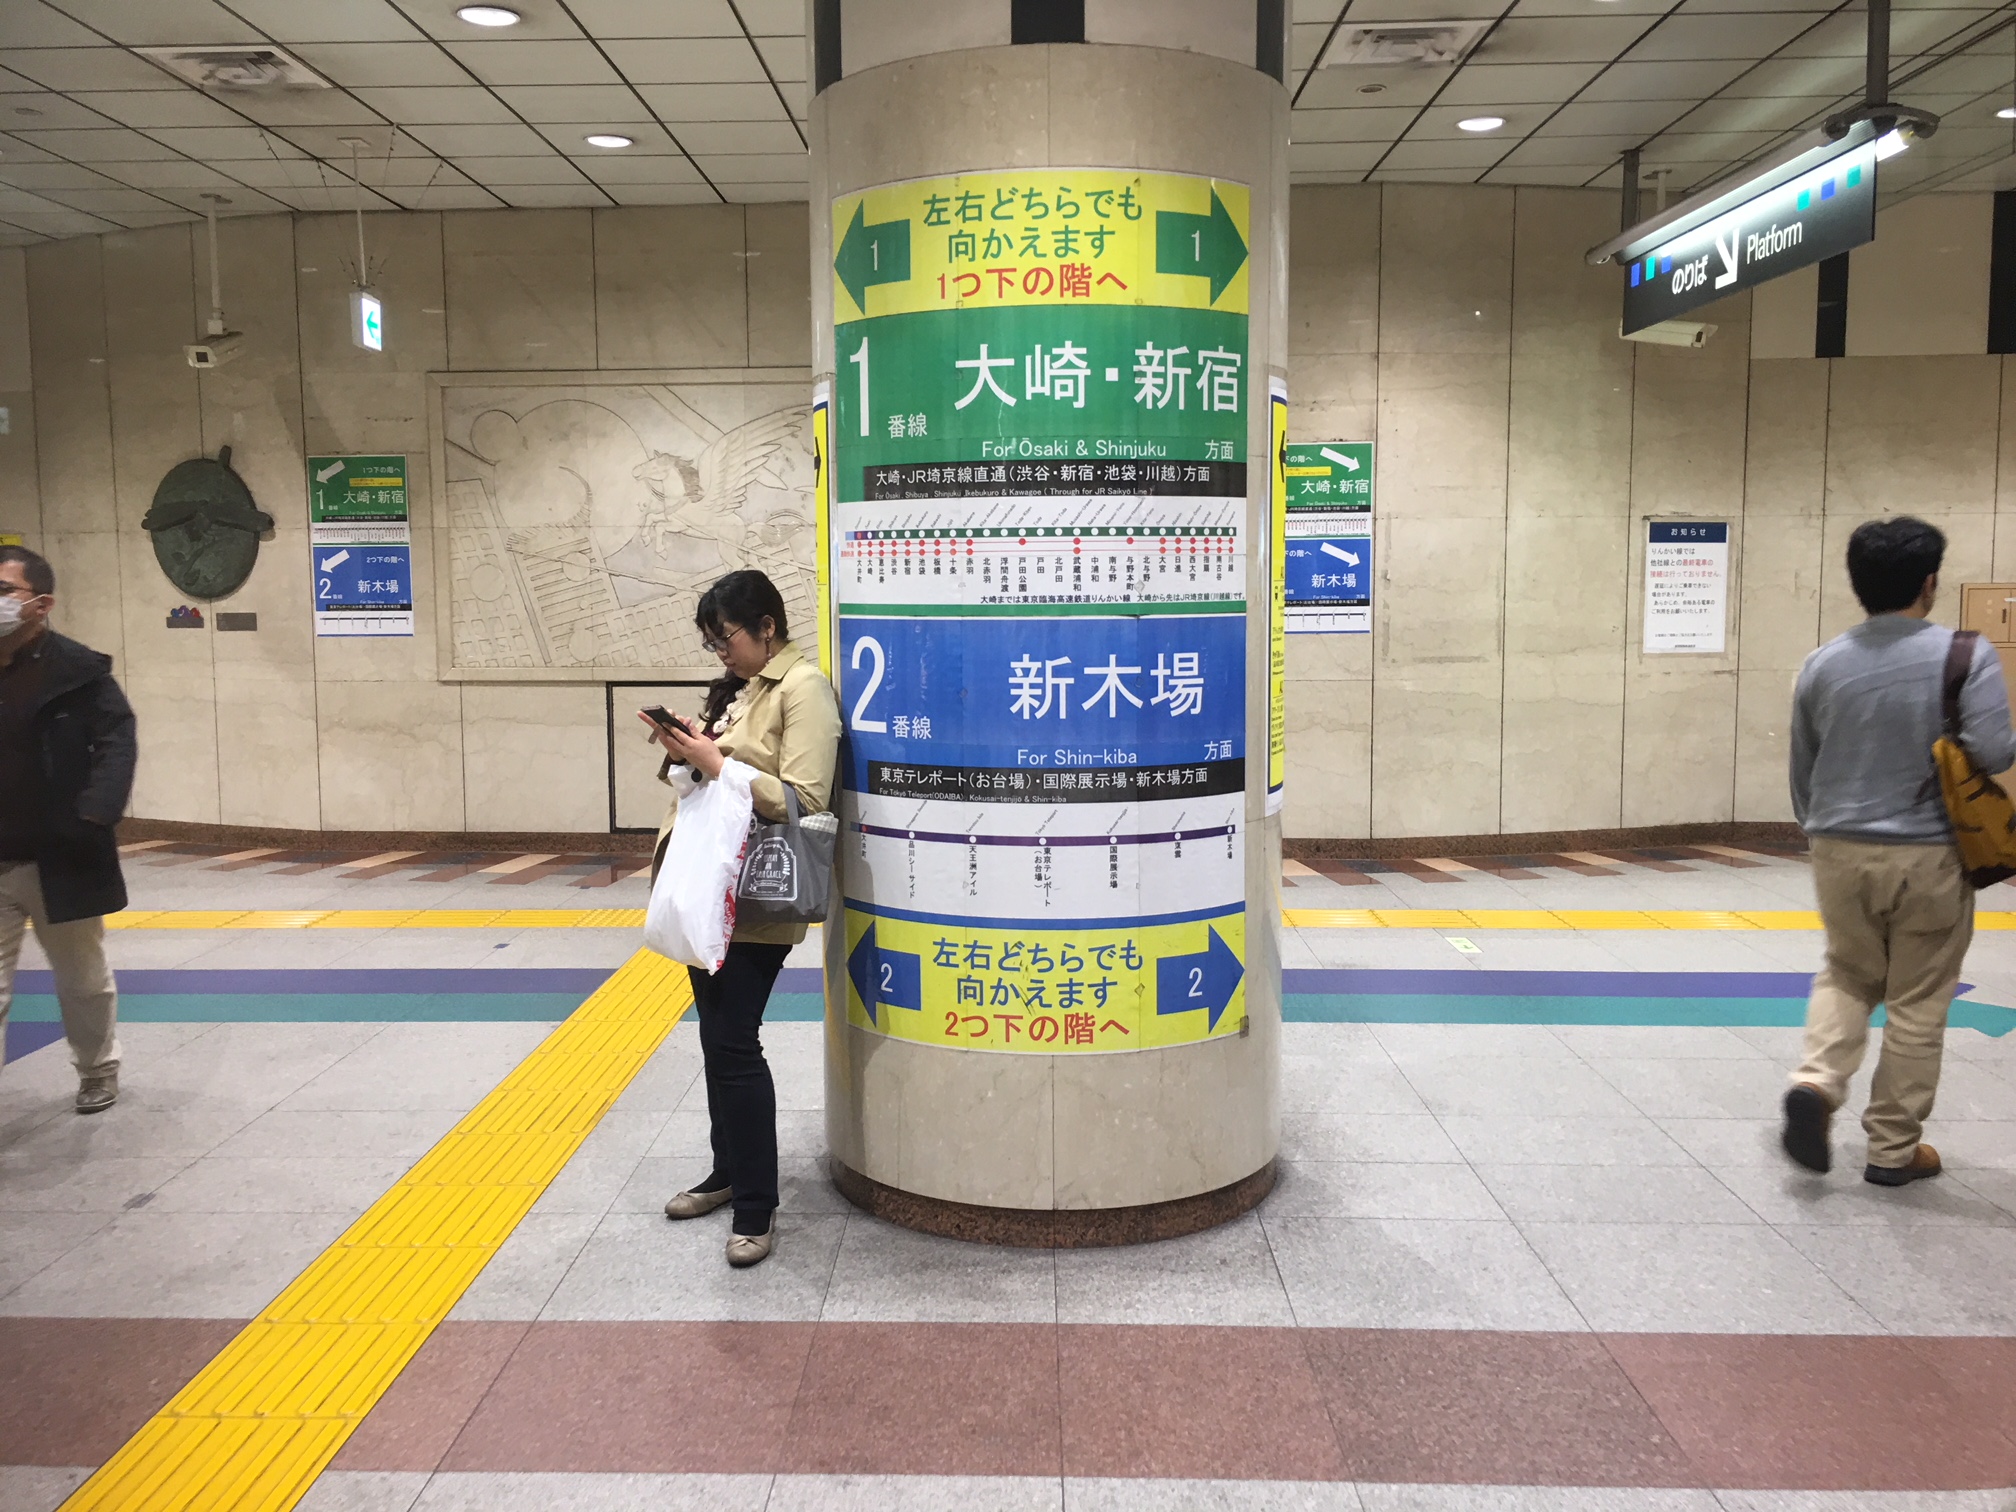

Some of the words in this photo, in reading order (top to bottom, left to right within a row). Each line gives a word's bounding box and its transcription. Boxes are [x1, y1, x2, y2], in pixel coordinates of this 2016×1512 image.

[923, 186, 1143, 227] 左右どちらでも
[869, 240, 878, 271] 1
[948, 228, 1115, 263] 向かえます
[1191, 230, 1200, 262] 1
[1747, 221, 1802, 264] Platform
[938, 263, 1128, 299] 1つ下の階へ
[1672, 255, 1709, 295] のりば
[850, 336, 870, 437] 1
[954, 340, 1241, 413] 大崎・新宿
[888, 412, 928, 439] 番線
[982, 441, 1011, 458] For
[1076, 440, 1089, 457] &
[1095, 440, 1166, 459] Shinjuku
[1205, 440, 1235, 460] 方面
[316, 489, 324, 510] 1
[343, 490, 404, 504] 大崎・新宿
[1009, 488, 1042, 497] Kawagoe
[1050, 487, 1080, 496] Through
[1082, 488, 1092, 496] for
[1095, 488, 1105, 496] JR
[1133, 488, 1147, 496] Line
[1301, 479, 1369, 494] 大崎・新宿
[1671, 528, 1707, 536] お知らせ
[966, 558, 974, 575] 赤羽
[983, 557, 991, 583] 北赤羽
[1018, 557, 1027, 592] 戸田公園
[1037, 557, 1045, 574] 戸田
[1055, 557, 1063, 582] 北戸田
[1073, 556, 1081, 592] 武蔵浦和
[1091, 557, 1099, 582] 中浦和
[1108, 556, 1117, 582] 南与野
[1126, 556, 1134, 591] 与野本町
[1159, 556, 1166, 573] 大宮
[319, 578, 332, 599] 2
[357, 579, 399, 594] 新木場
[1311, 573, 1357, 588] 新木場
[851, 635, 887, 733] 2
[1008, 652, 1204, 720] 新木場
[892, 715, 932, 740] 番線
[1017, 749, 1047, 765] For
[1054, 748, 1137, 766] Shin-kiba
[1204, 740, 1232, 761] 方面
[1043, 848, 1052, 907] 東京テレポート
[1109, 846, 1118, 889] 国際展示場
[932, 938, 1144, 972] 左右どちらでも
[880, 963, 893, 992] 2
[1188, 968, 1202, 997] 2
[957, 976, 1118, 1009] 向かえます
[945, 1012, 1130, 1045] 2つ下の階へ
